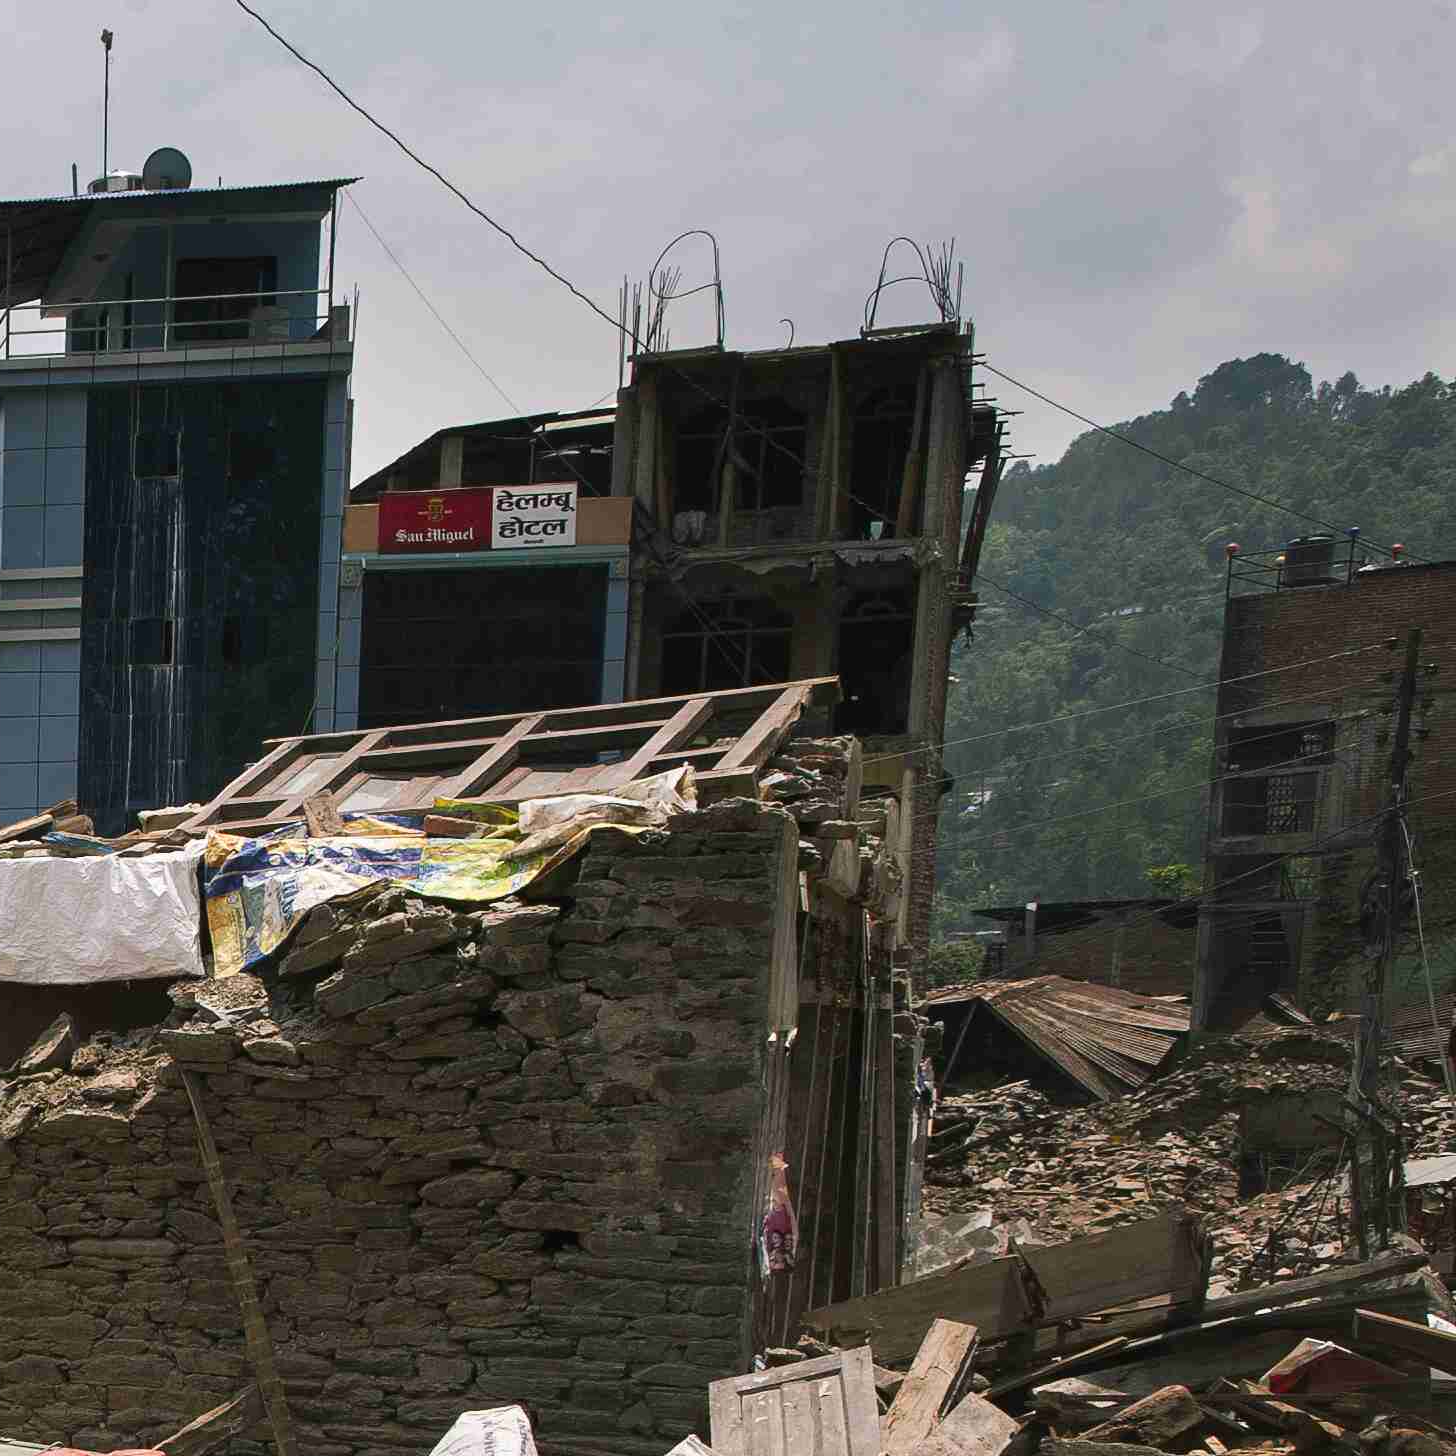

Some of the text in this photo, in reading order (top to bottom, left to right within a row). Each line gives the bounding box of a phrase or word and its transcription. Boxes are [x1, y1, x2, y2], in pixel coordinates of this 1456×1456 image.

[496, 490, 575, 512] हेलम्बू
[395, 527, 474, 543] San Miguel
[499, 516, 568, 538] होटल
